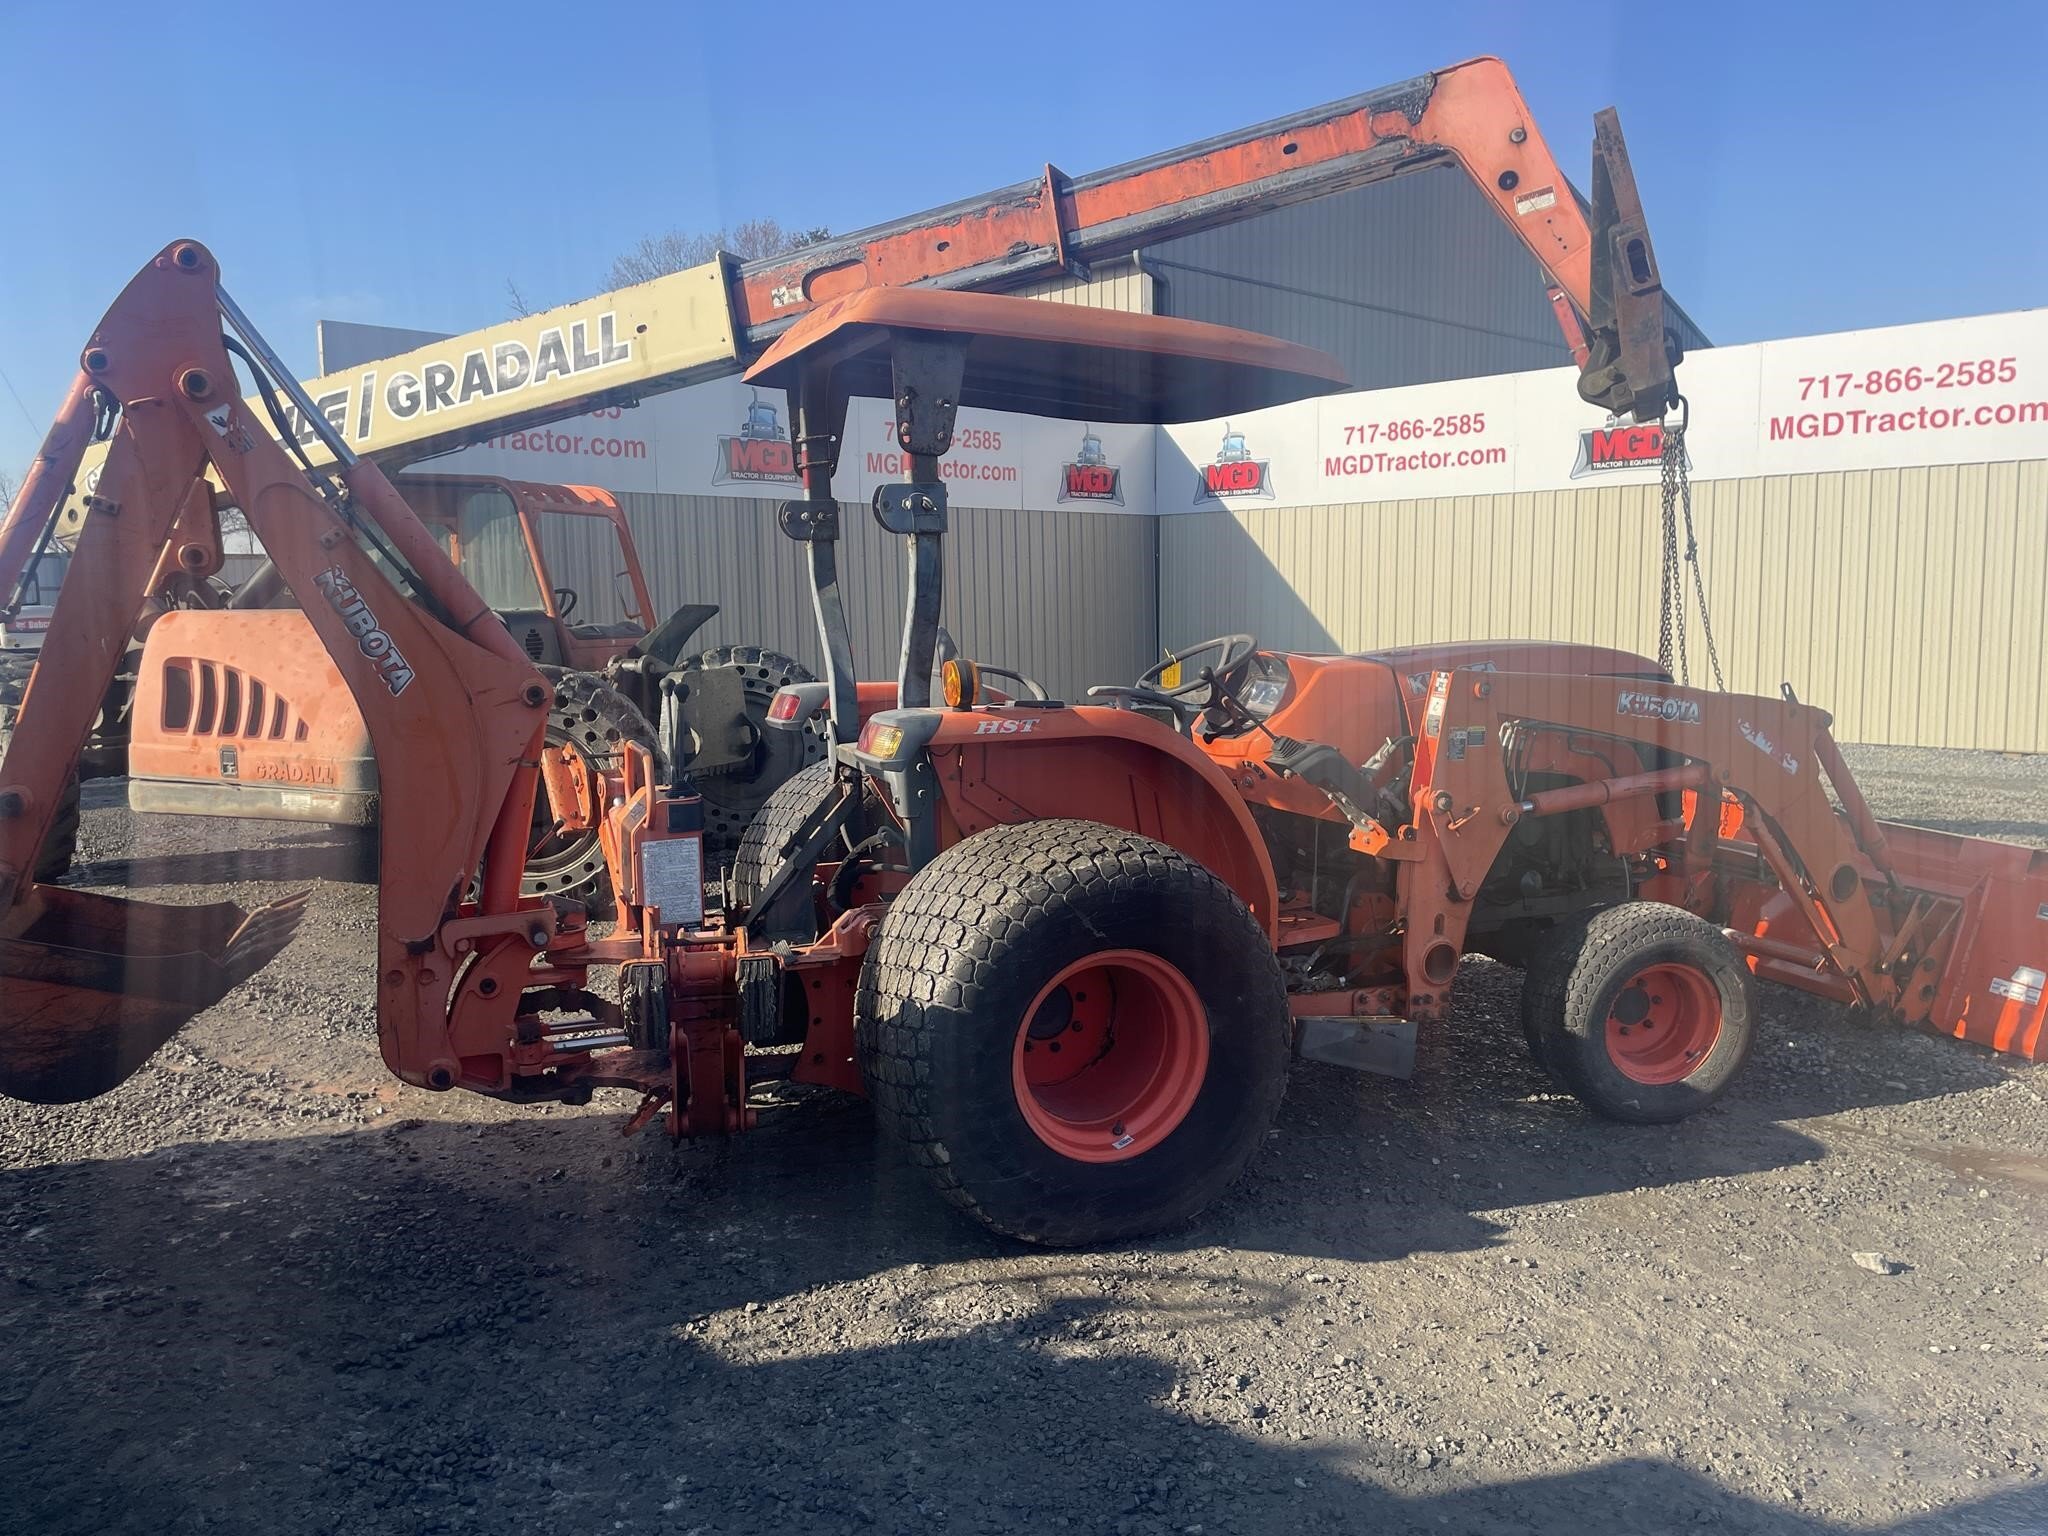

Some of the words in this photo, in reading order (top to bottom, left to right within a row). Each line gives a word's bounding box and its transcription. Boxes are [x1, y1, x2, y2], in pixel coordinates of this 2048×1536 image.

[385, 311, 632, 420] GRADALL
[1798, 357, 2017, 401] 717-866-2585
[885, 421, 1001, 450] 7-2585
[1344, 413, 1485, 446] 717-866-2585
[1769, 401, 2048, 441] MGDTractor.com
[487, 429, 646, 459] actor.com
[729, 437, 794, 473] MGD
[1592, 426, 1665, 462] MGD
[732, 471, 760, 480] TRACTOR
[764, 473, 797, 481] EQUIPMENT
[867, 452, 1016, 481] MGctor.com
[1207, 462, 1260, 491] MGD
[1325, 446, 1506, 477] MGDTractor.com
[1593, 461, 1623, 469] TRACTOR
[1630, 458, 1663, 466] EQUIPME
[1068, 464, 1113, 492] MGD
[312, 565, 415, 697] KUBOTA
[1617, 689, 1702, 725] KUBOTA
[973, 718, 1041, 735] HST
[256, 760, 335, 785] GRADALL
